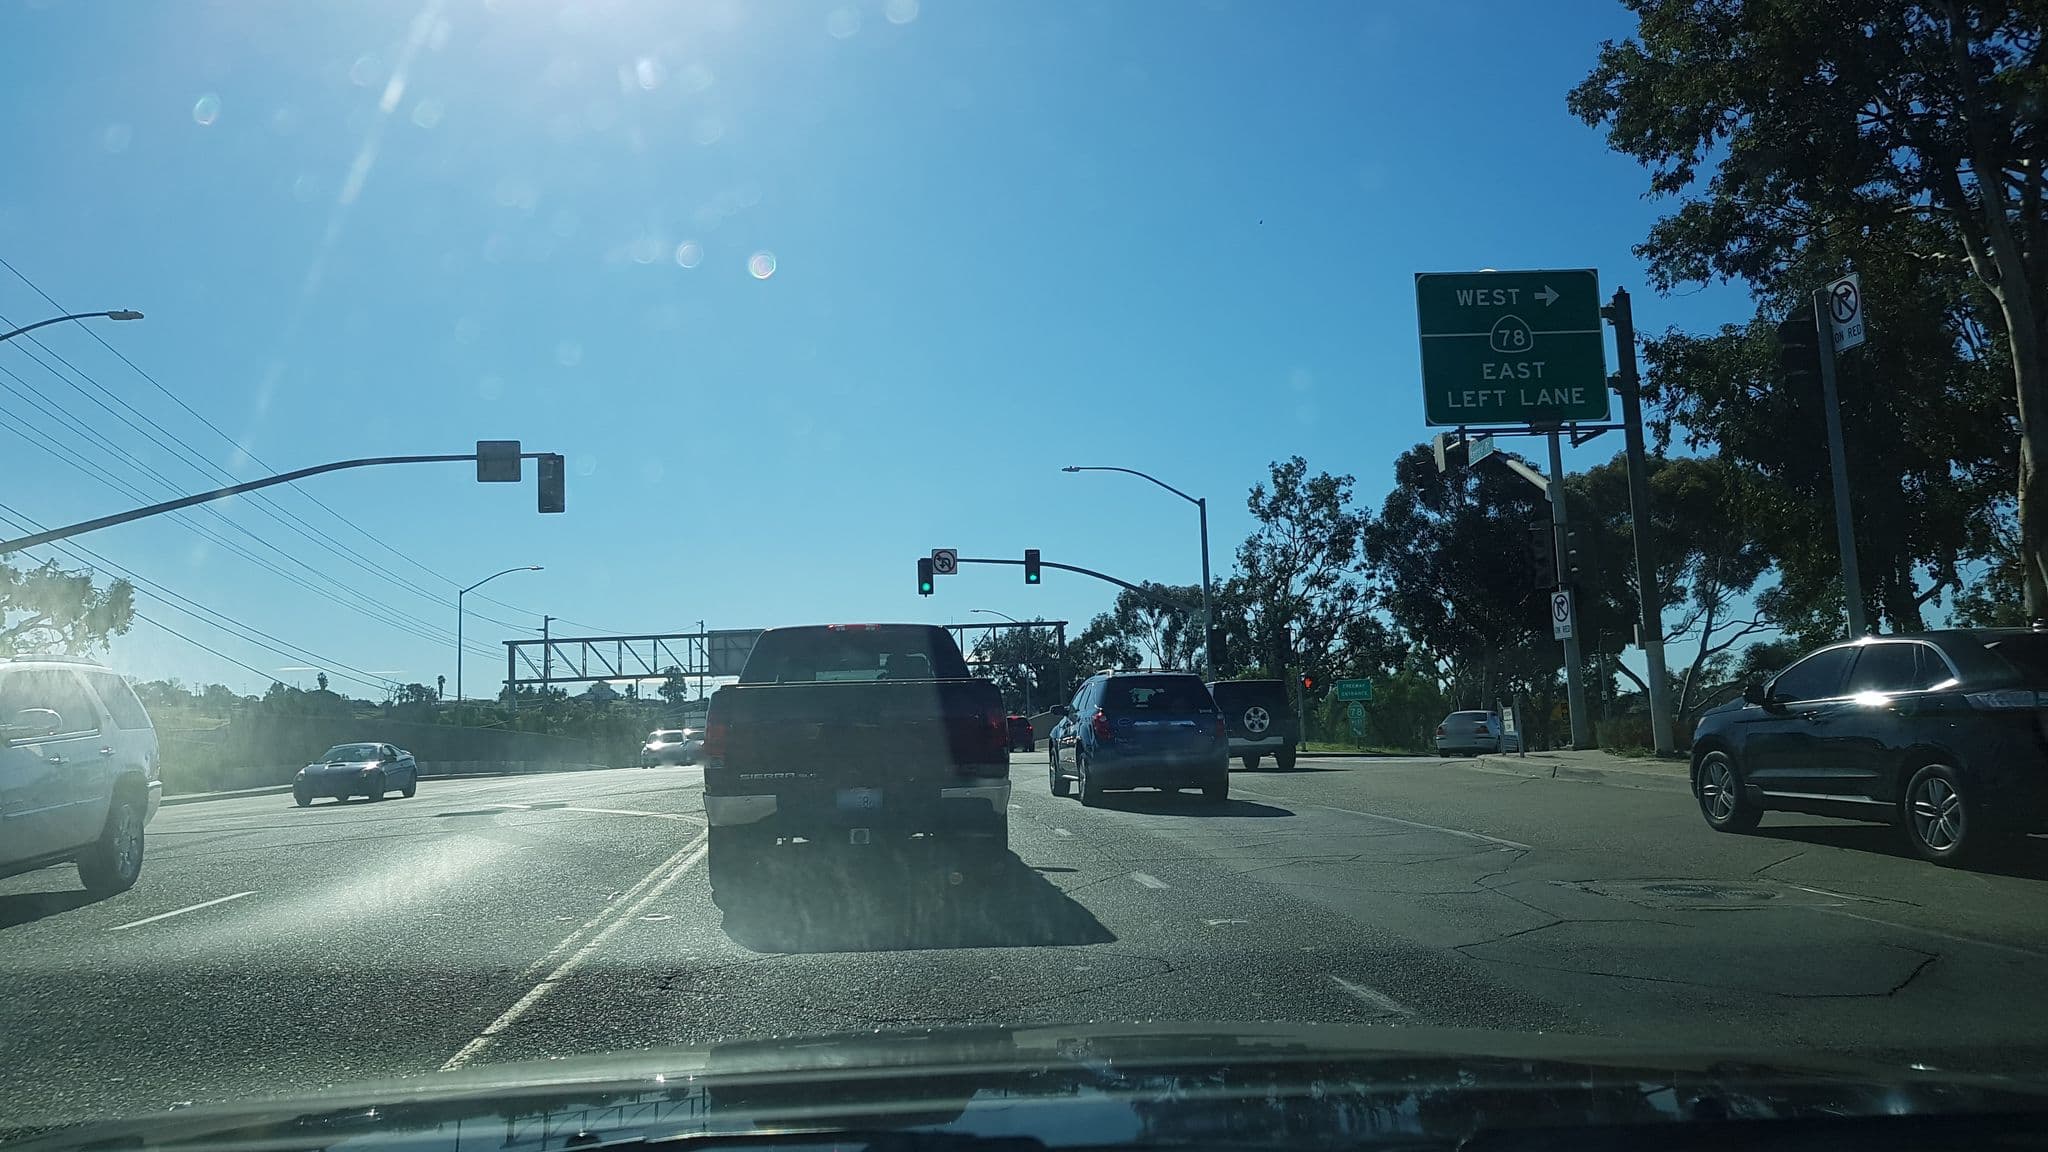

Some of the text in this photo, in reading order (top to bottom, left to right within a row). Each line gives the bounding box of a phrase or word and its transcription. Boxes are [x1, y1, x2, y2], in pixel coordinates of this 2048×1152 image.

[1456, 289, 1520, 306] WEST
[1498, 330, 1525, 346] 78
[1834, 324, 1862, 342] ON RED
[1482, 362, 1545, 380] EAST
[1448, 387, 1585, 408] LEFT LANE
[1350, 708, 1363, 717] 78
